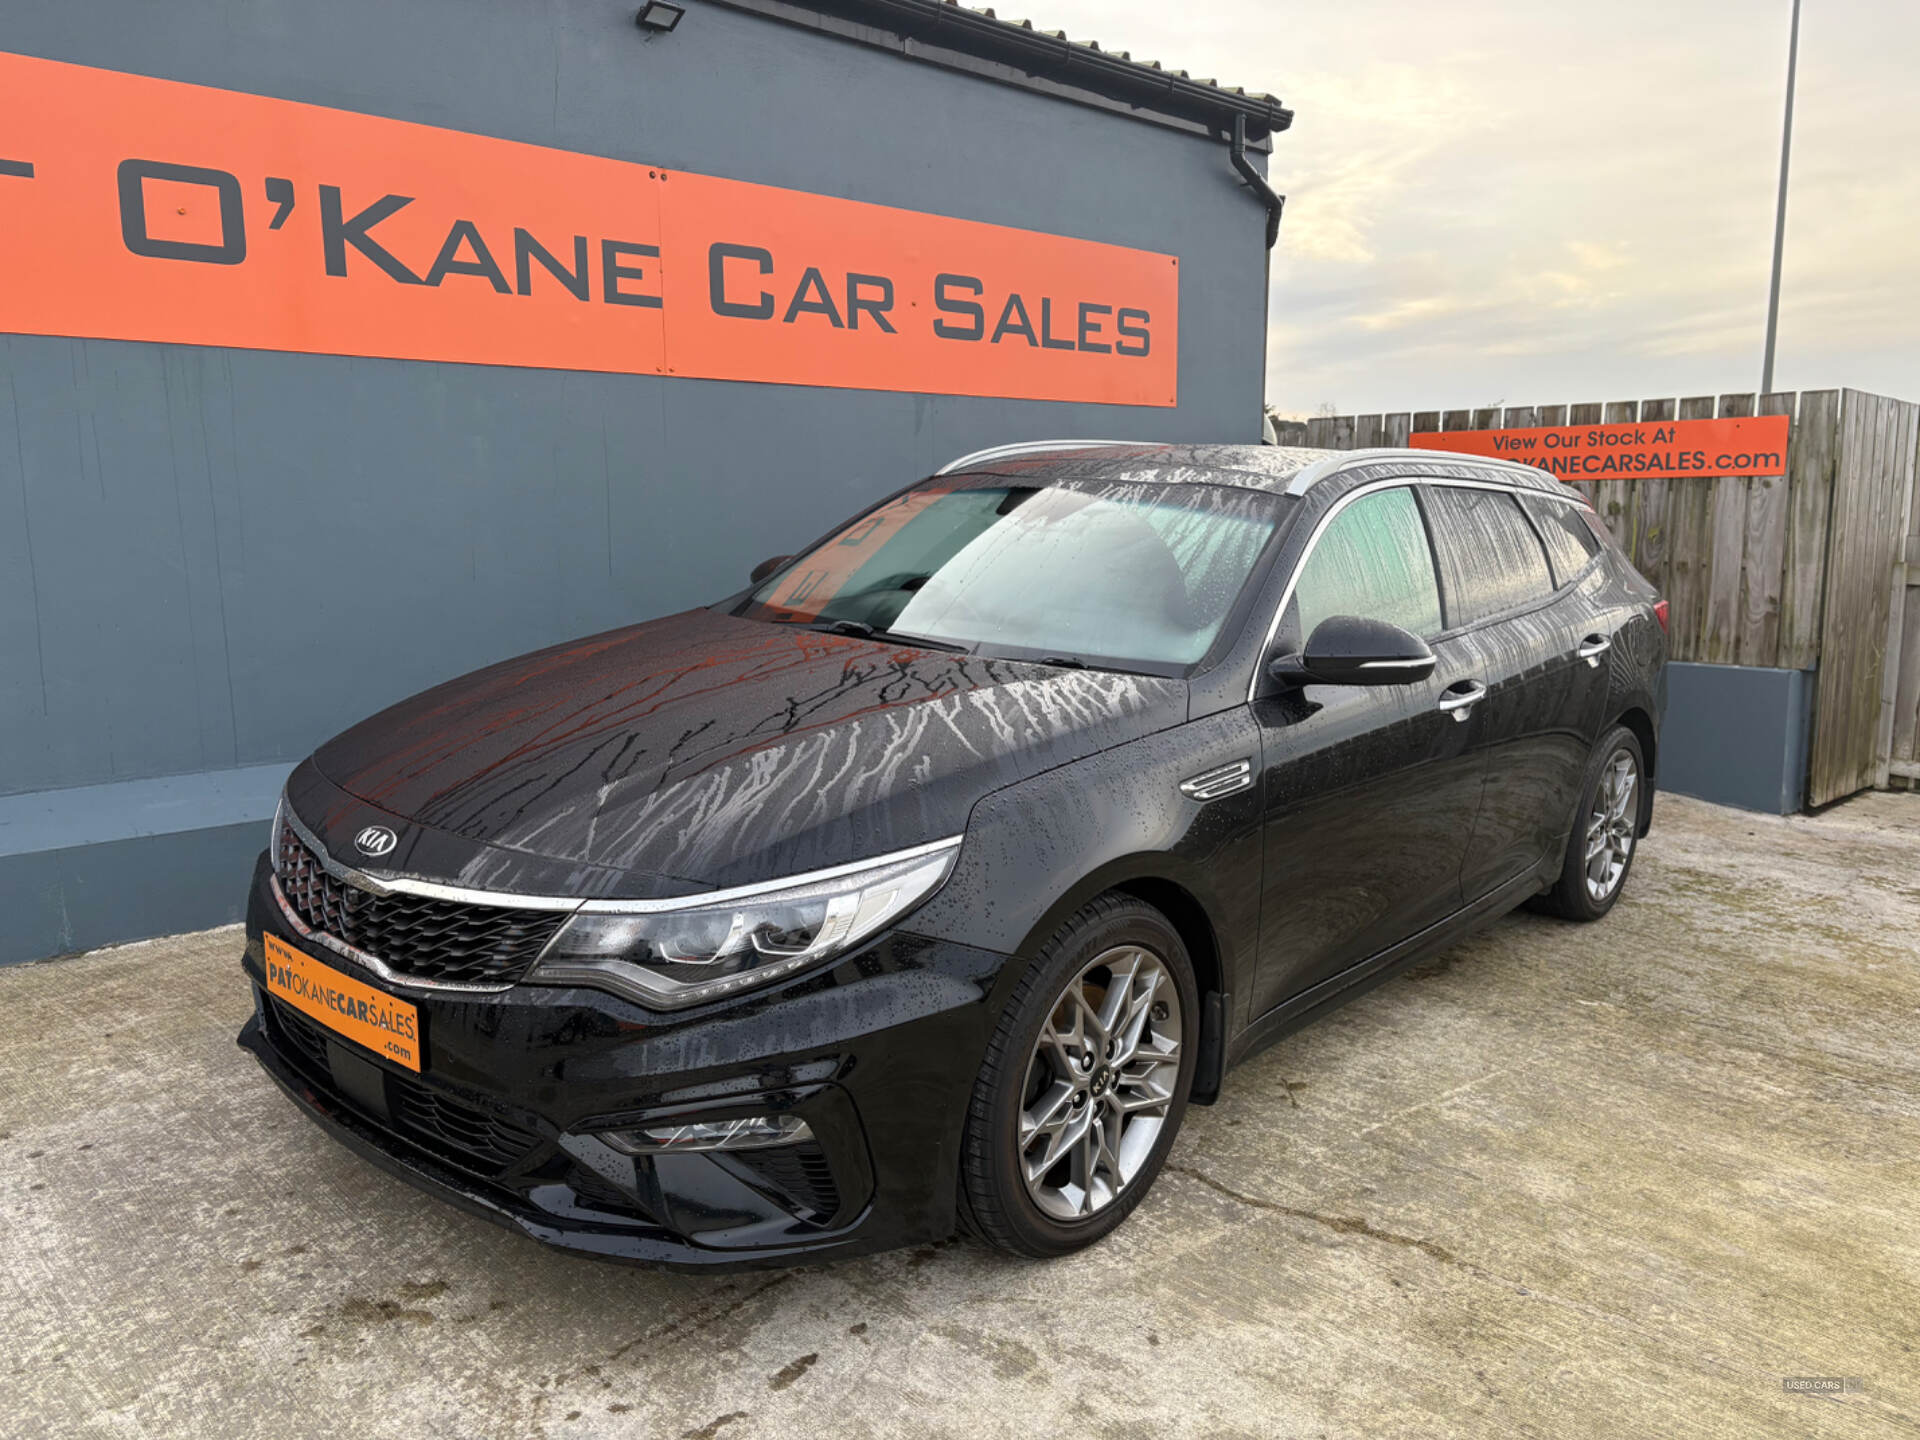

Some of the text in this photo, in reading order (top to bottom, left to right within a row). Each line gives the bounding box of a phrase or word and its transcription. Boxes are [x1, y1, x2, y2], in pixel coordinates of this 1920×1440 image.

[117, 158, 1151, 358] O'KANE CAR SALES
[1493, 427, 1676, 451] View Our Stock At
[1508, 451, 1780, 476] ANECARSALES.com
[358, 827, 389, 852] KIA
[384, 1041, 411, 1061] .com
[1092, 1070, 1109, 1094] KIA
